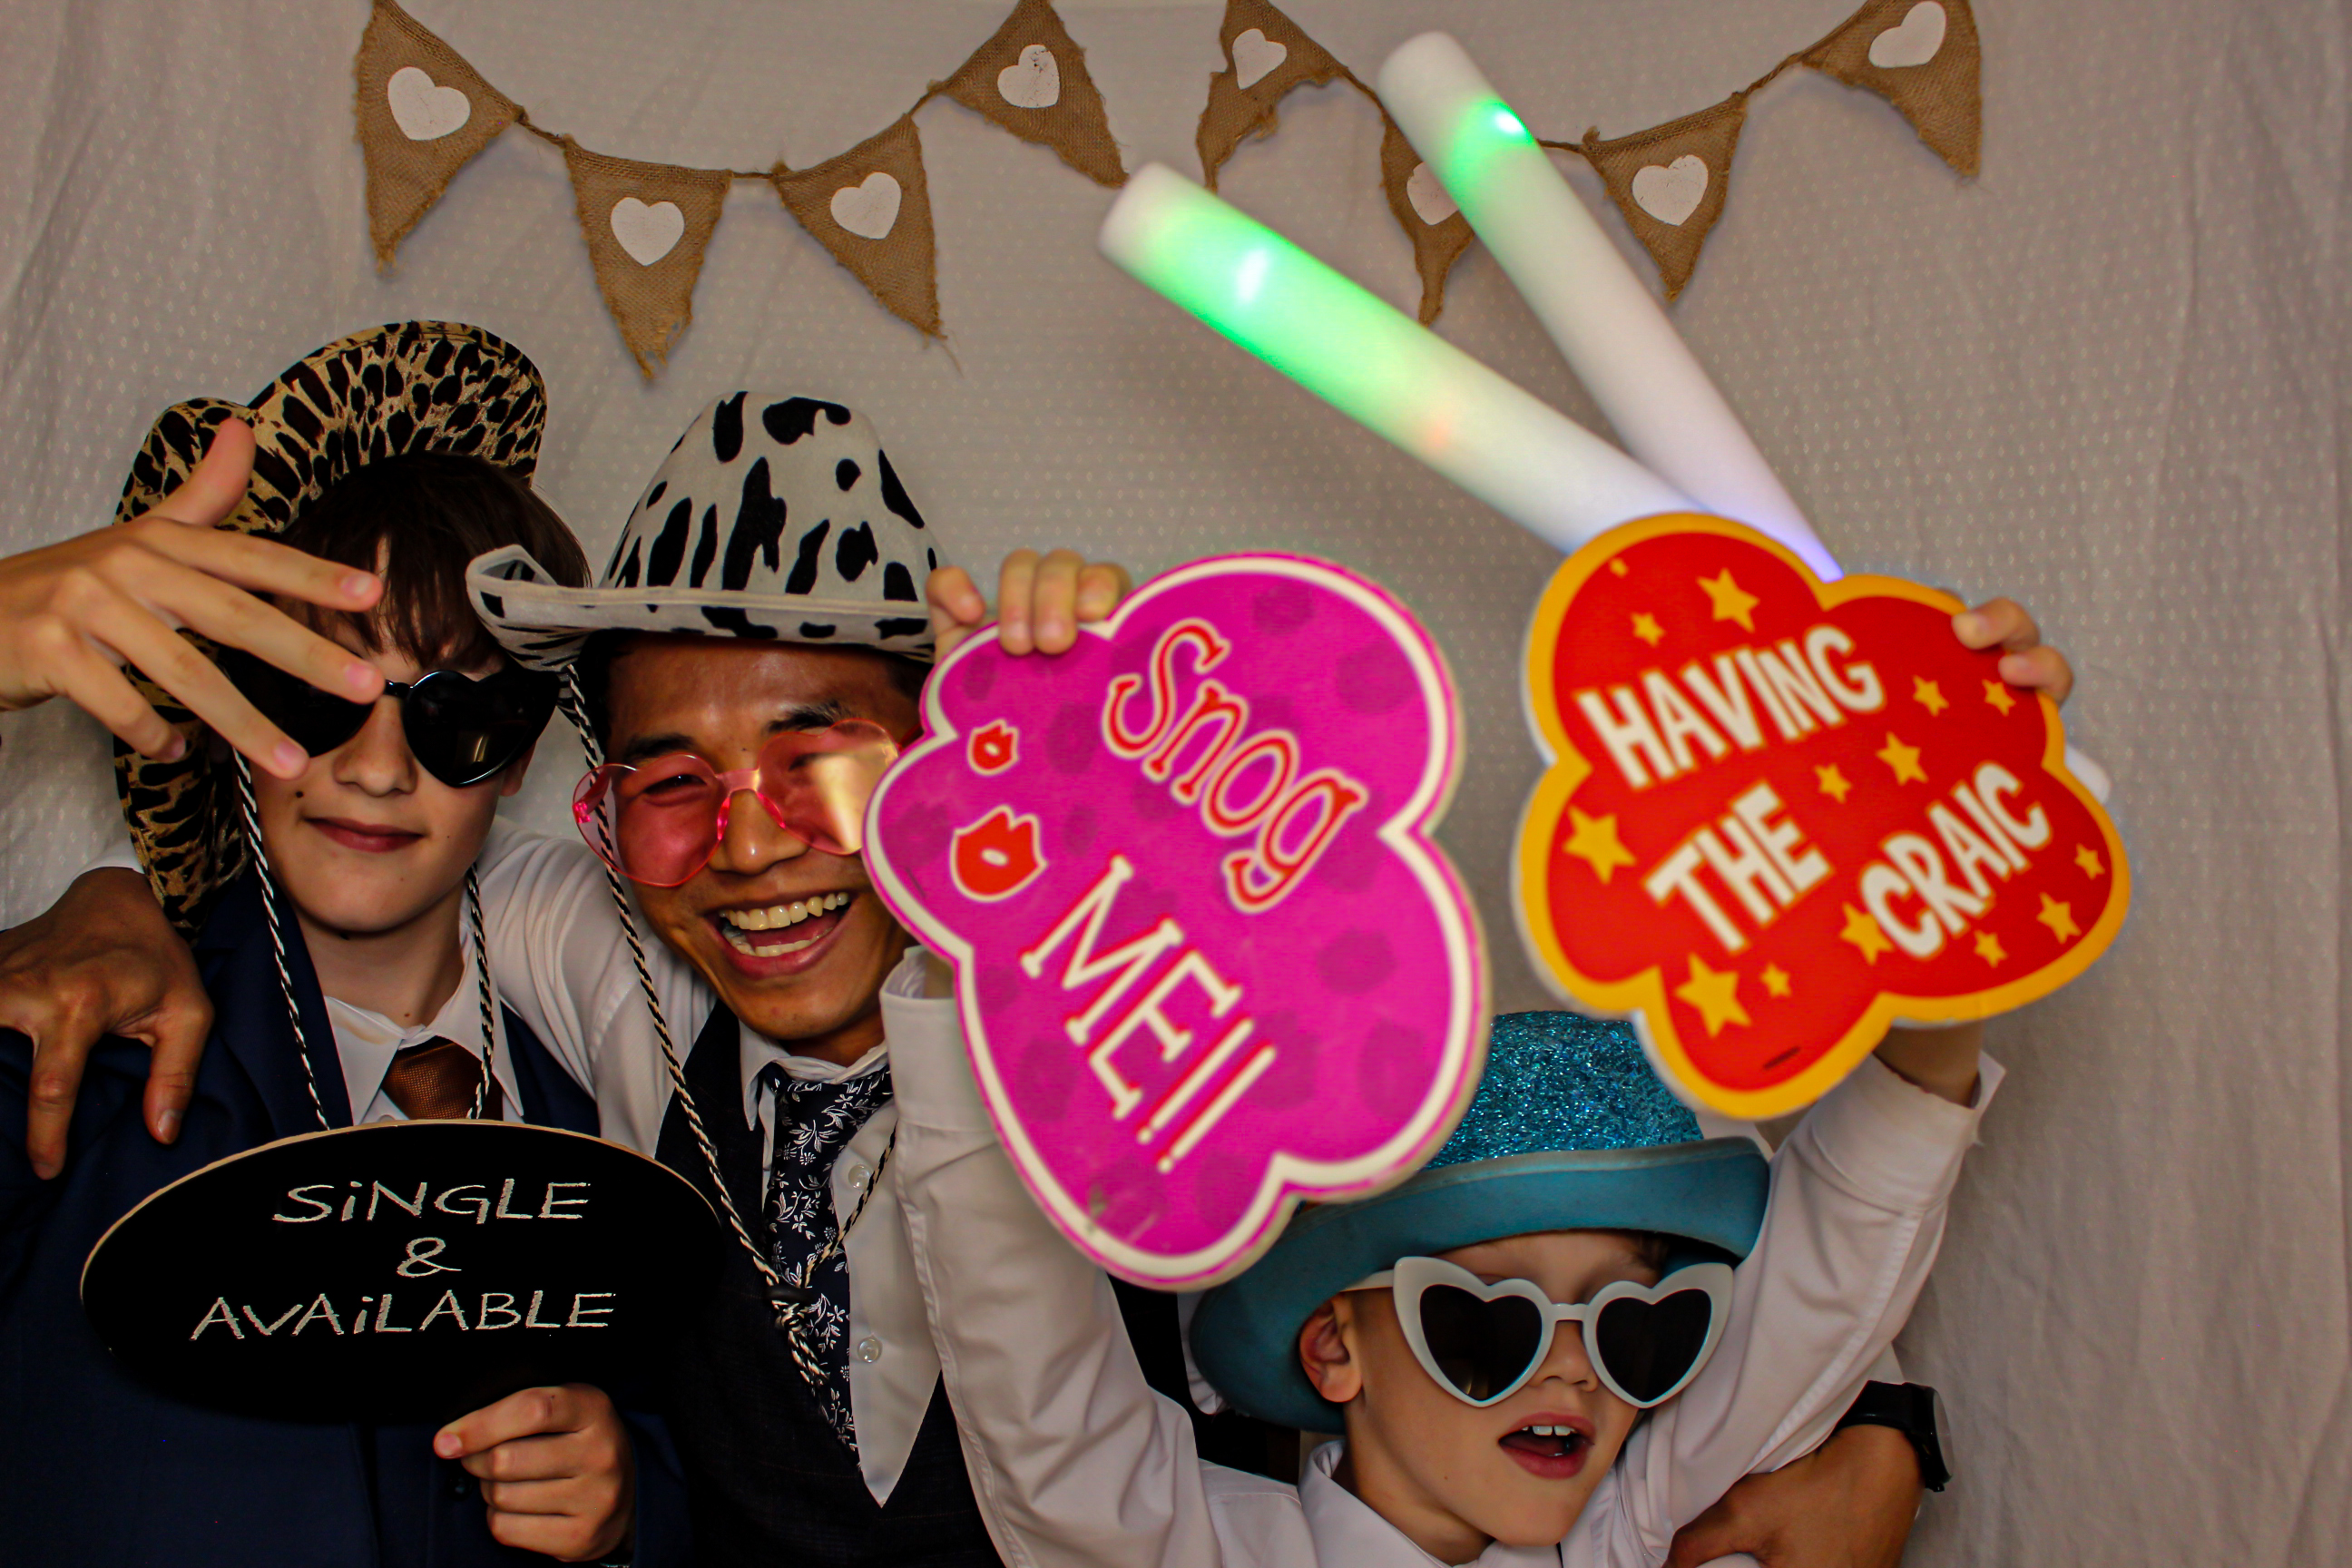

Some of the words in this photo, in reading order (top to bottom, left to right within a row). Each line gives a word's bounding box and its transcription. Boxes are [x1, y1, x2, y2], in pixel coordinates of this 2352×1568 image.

[1102, 618, 1368, 913] Snog
[1574, 625, 1885, 790] HAVING
[1643, 780, 1834, 953] THE
[1859, 761, 2051, 958] CRAIC
[397, 1237, 462, 1277] &
